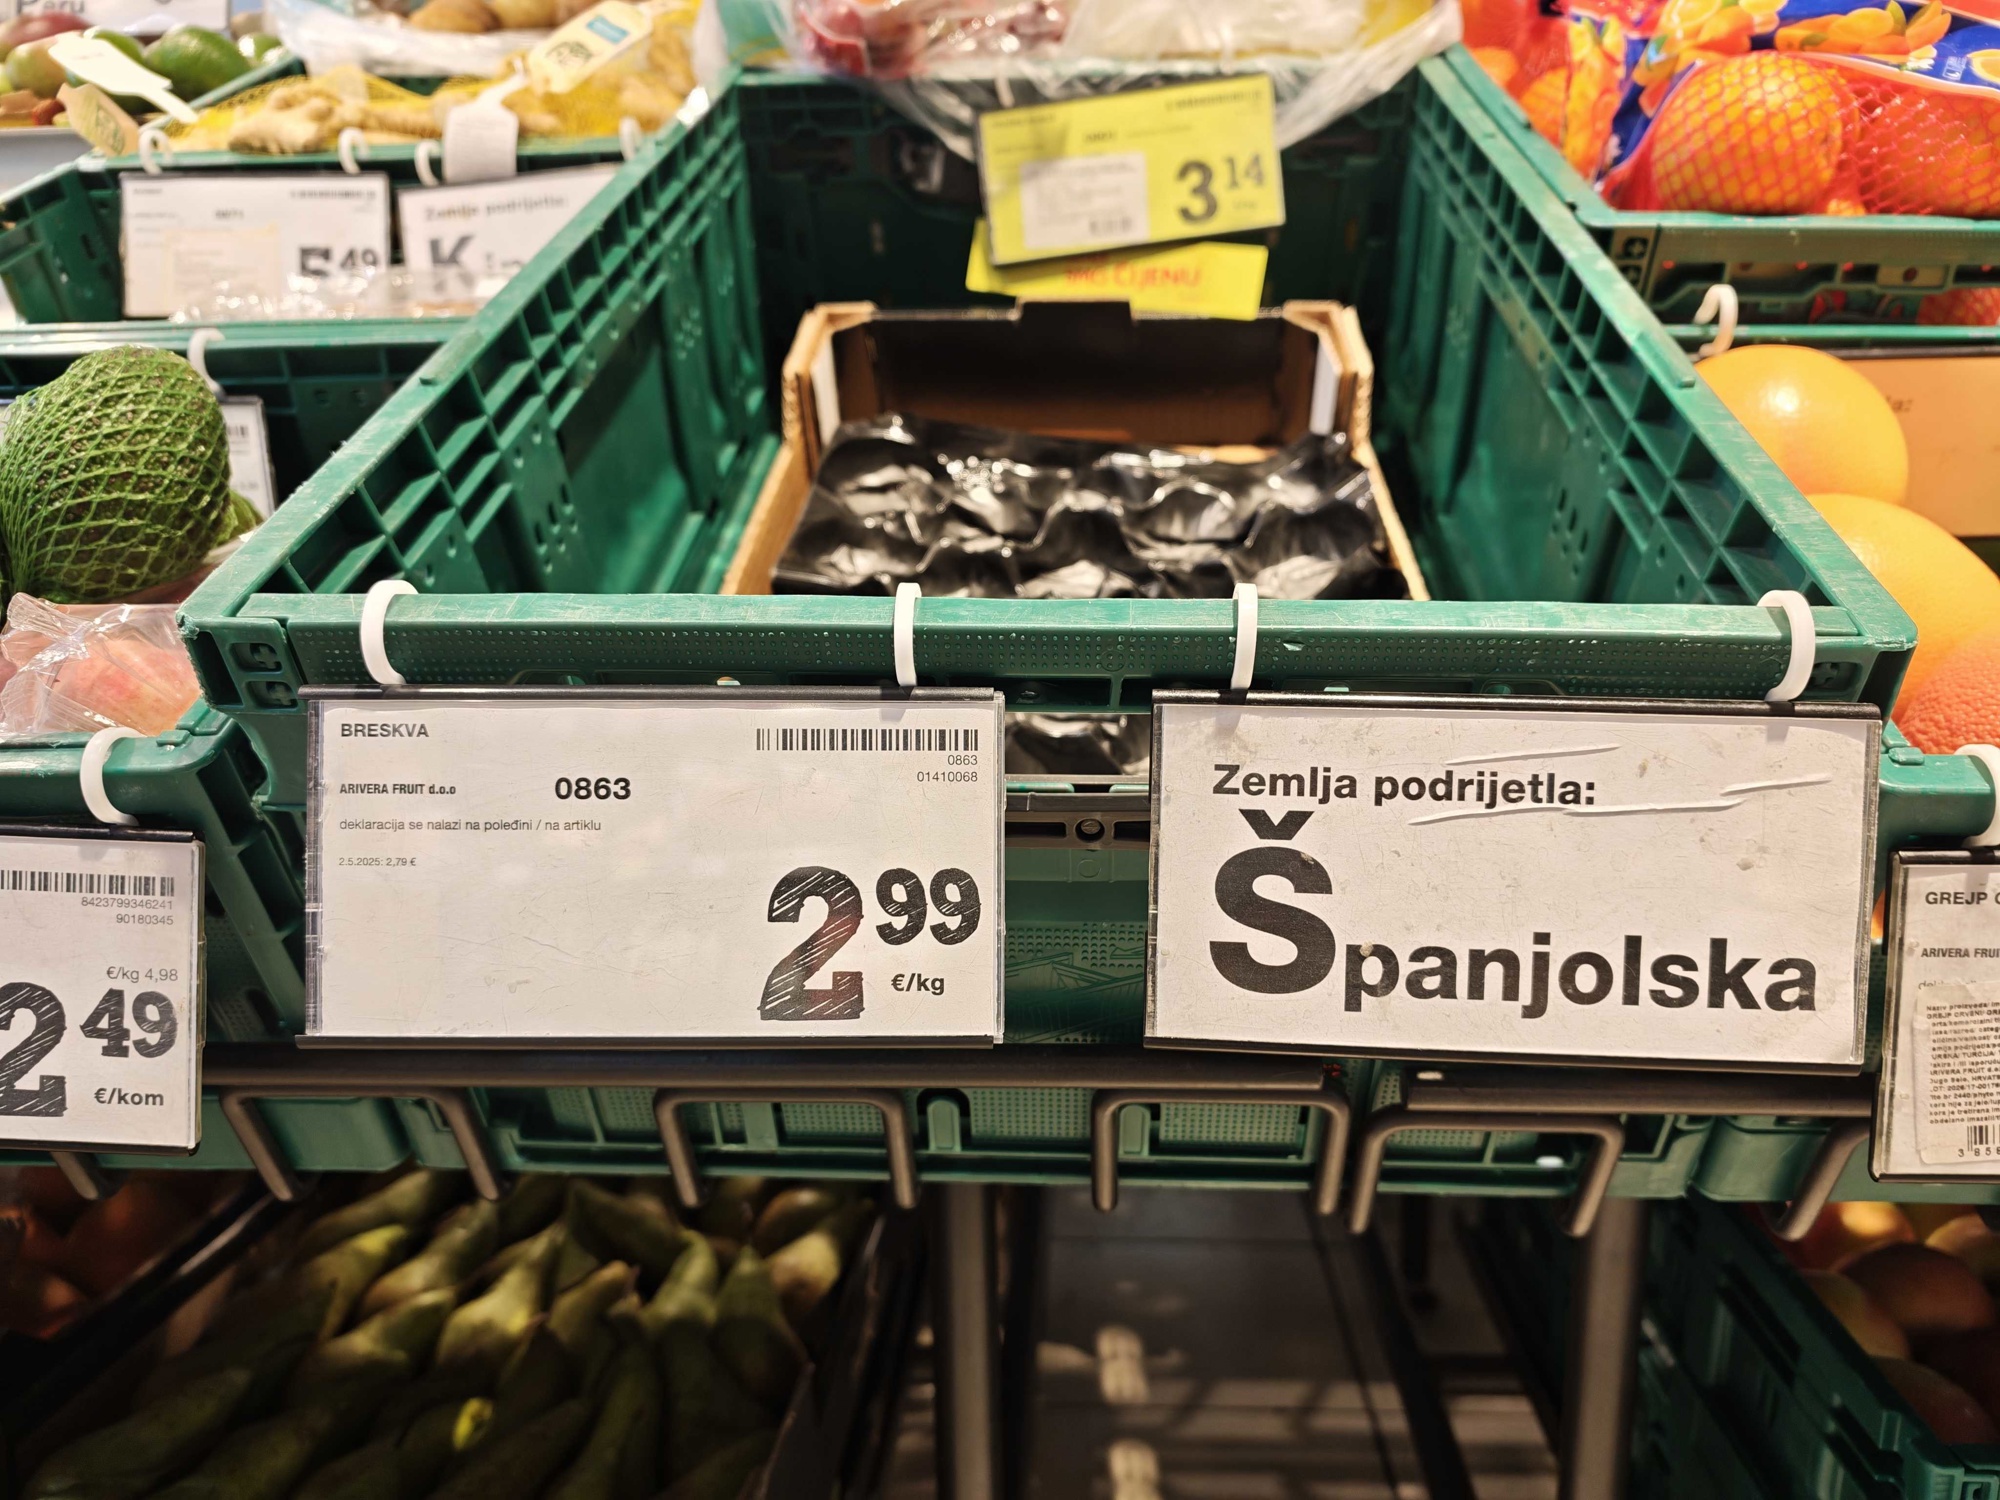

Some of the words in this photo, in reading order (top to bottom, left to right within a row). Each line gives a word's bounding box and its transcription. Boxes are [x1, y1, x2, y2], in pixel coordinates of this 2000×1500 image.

[1175, 160, 1217, 223] 3
[1223, 154, 1266, 190] 14
[340, 723, 430, 738] BRESKVA
[947, 755, 978, 766] 0863
[916, 771, 978, 783] 01410068
[339, 783, 389, 795] ARIVERA
[392, 784, 425, 796] FRUIT
[428, 784, 456, 795] d.o.o
[554, 777, 632, 800] 0863
[1212, 764, 1359, 804] Zemlja
[1374, 769, 1596, 808] podrijetla:
[339, 819, 405, 832] deklaracija
[409, 822, 423, 831] se
[426, 819, 462, 831] nalazi
[465, 822, 481, 831] na
[484, 818, 533, 832] poleđini
[535, 819, 542, 831] /
[545, 822, 560, 831] na
[563, 819, 601, 831] artiklu
[338, 857, 384, 867] 2.5.2025:
[386, 857, 407, 868] 2,79
[410, 857, 416, 867] €
[81, 897, 173, 911] 8423799346241
[1925, 892, 1988, 905] GREJP
[116, 914, 174, 926] 90180345
[1209, 809, 1818, 1020] Španjolska
[757, 866, 865, 1021] 2
[876, 868, 981, 945] 99
[1920, 948, 1970, 959] ARIVERA
[106, 966, 140, 983] €/kg
[144, 969, 178, 982] 4,98
[891, 973, 945, 996] €/kg
[0, 981, 68, 1117] 2
[80, 987, 178, 1058] 49
[94, 1088, 164, 1106] €/kom
